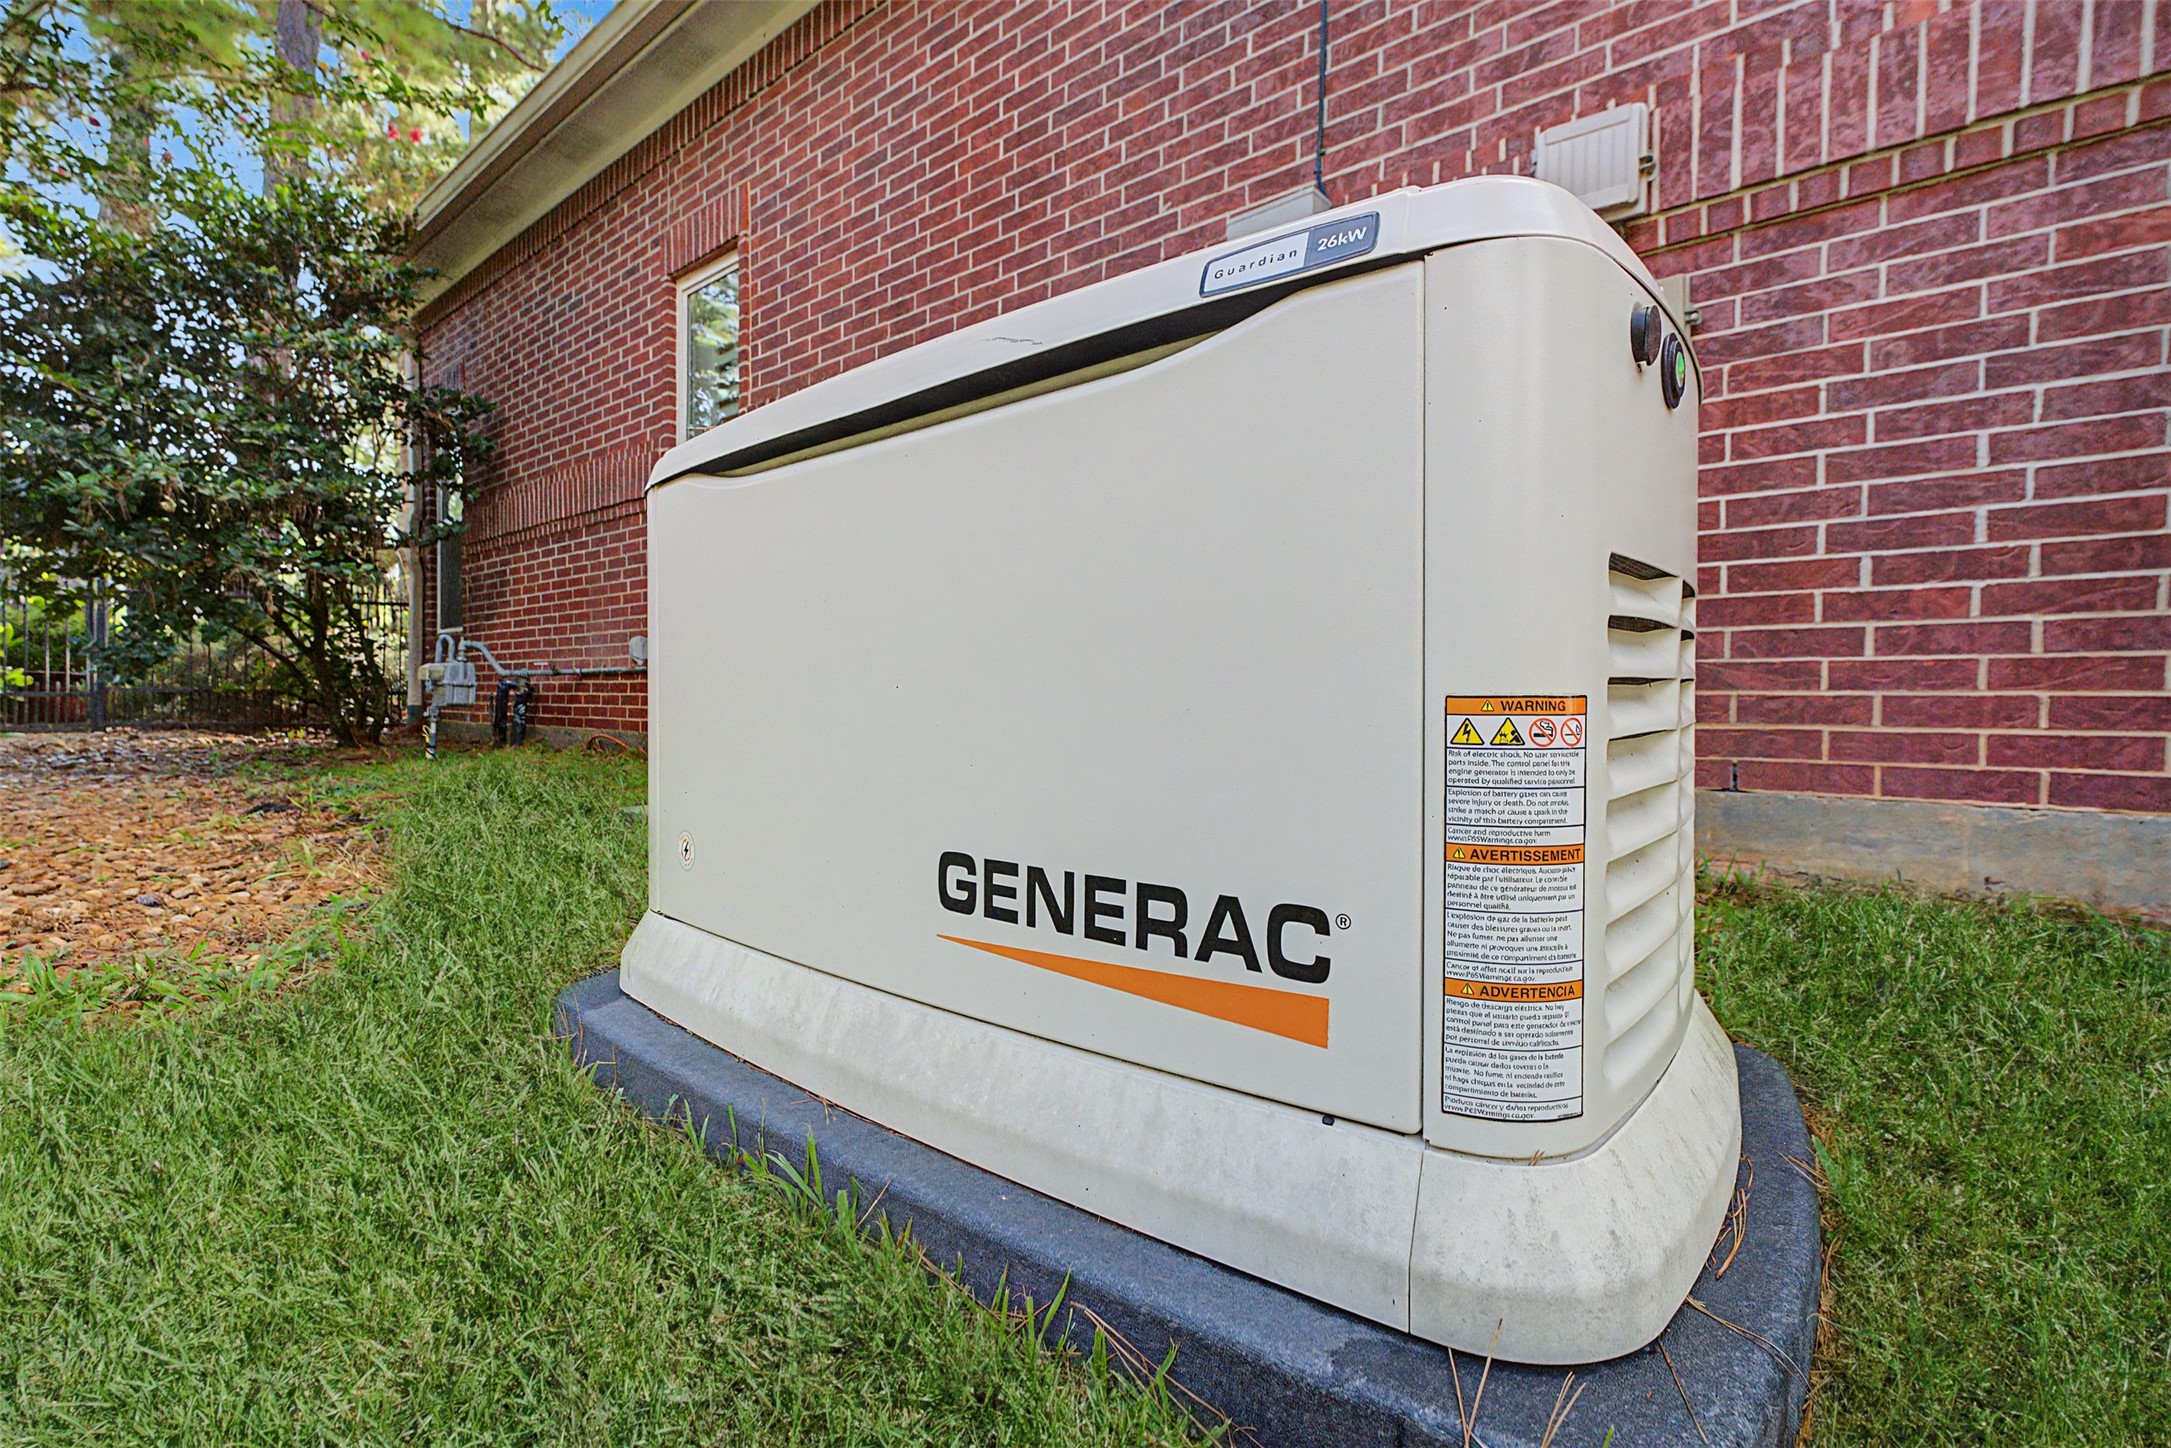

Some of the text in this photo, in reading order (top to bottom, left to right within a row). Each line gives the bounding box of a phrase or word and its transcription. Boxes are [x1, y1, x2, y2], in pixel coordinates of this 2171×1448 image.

[1214, 226, 1368, 279] Guardian 26kW
[1500, 700, 1566, 711] WARNING
[1470, 848, 1581, 862] AVERTISSEMENT
[1479, 985, 1575, 998] ADVERTENCIA
